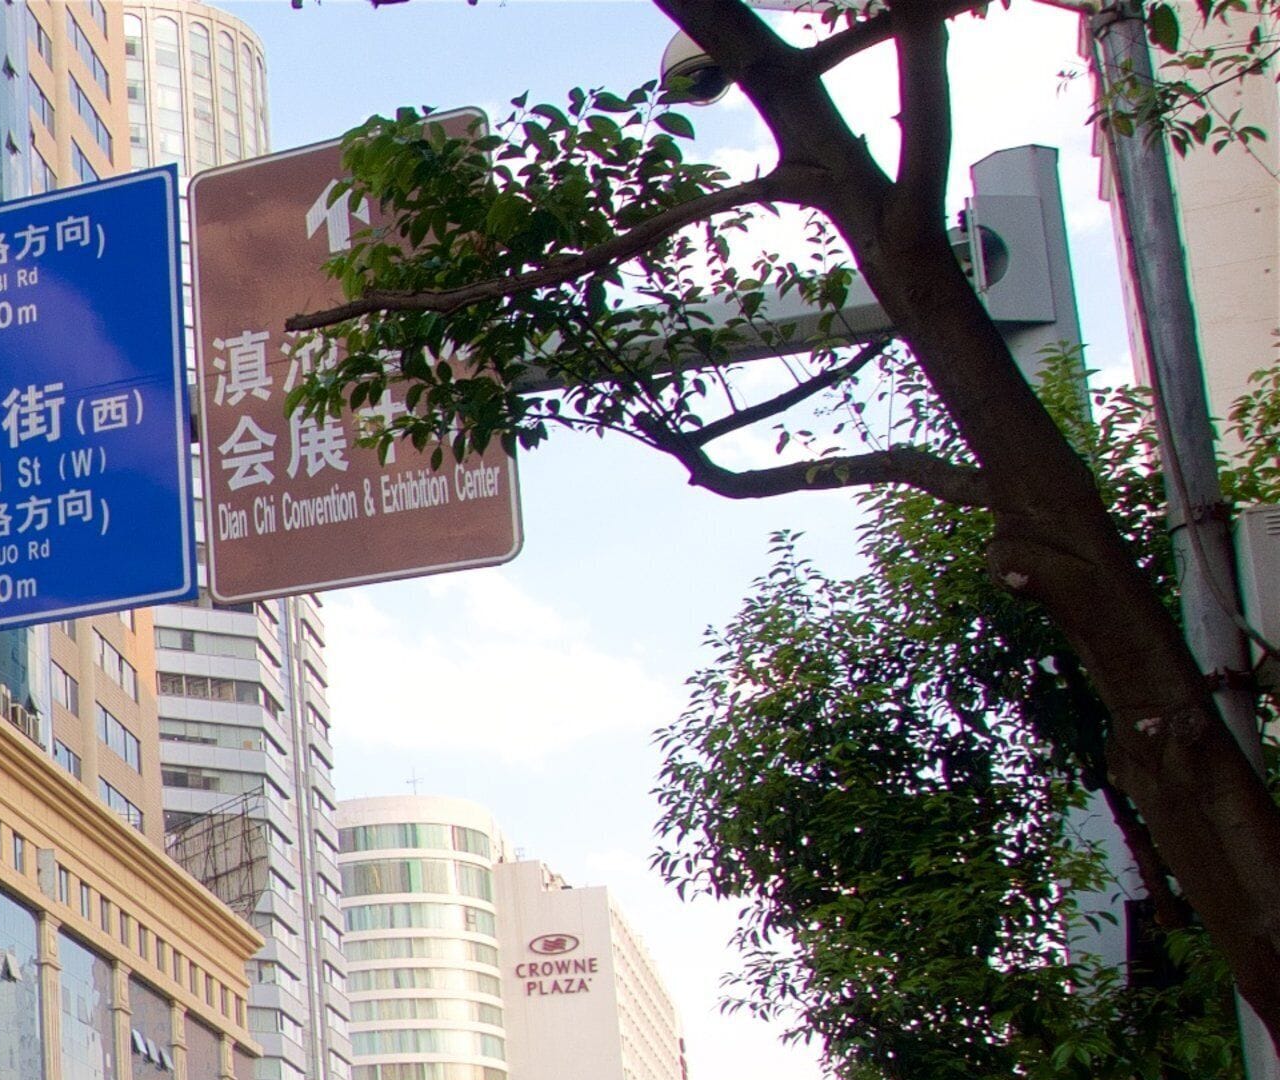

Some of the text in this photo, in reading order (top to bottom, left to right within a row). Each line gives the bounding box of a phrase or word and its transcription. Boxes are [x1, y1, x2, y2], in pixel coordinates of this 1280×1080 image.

[17, 266, 39, 288] Rd
[17, 456, 42, 488] St
[59, 446, 106, 481] (W)
[217, 460, 500, 541] Dian Chi Convention & Exhibition Center
[28, 538, 50, 562] Rd
[515, 957, 598, 979] CROWNE
[526, 977, 590, 996] PLAZA
